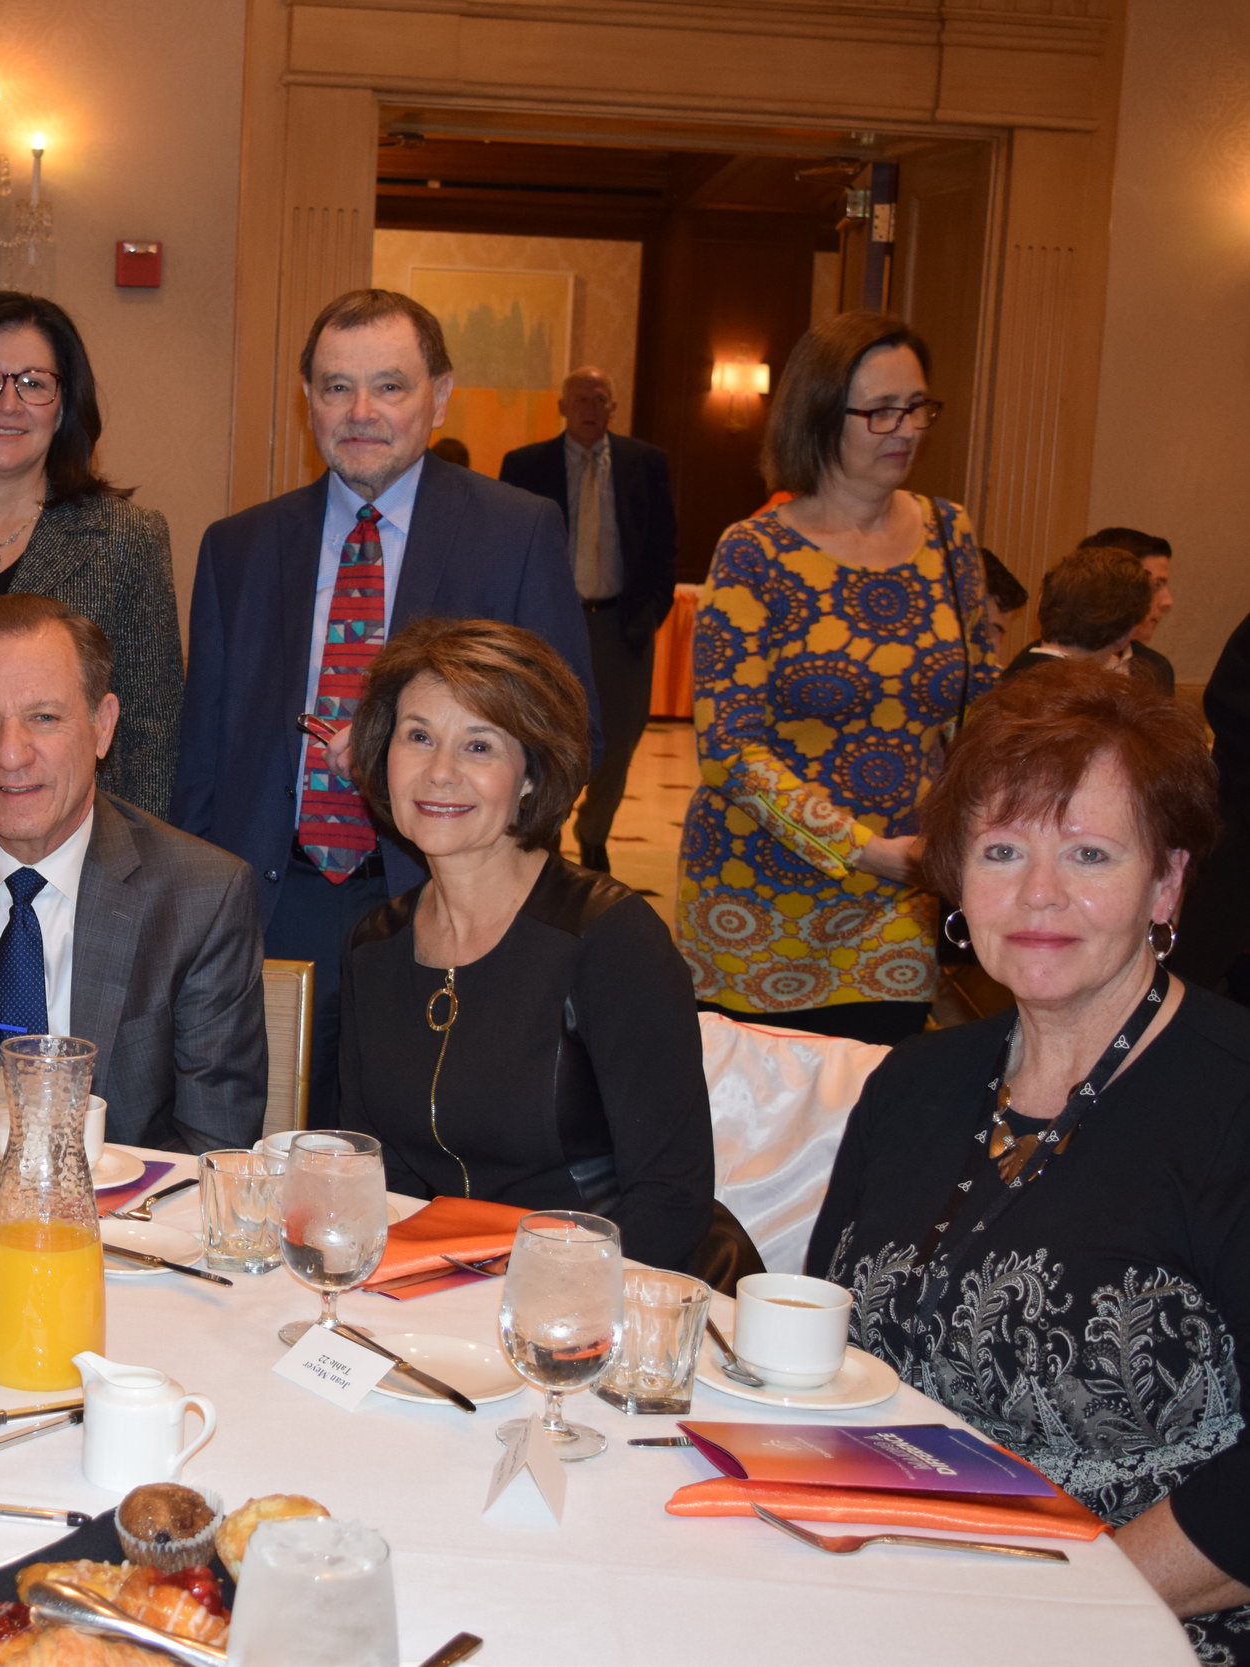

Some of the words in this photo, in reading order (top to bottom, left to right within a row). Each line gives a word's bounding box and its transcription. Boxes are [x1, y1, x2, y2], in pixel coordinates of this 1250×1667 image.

[318, 1354, 330, 1364] 22
[302, 1361, 329, 1379] Meyer
[329, 1360, 352, 1375] Table
[329, 1374, 351, 1389] Jean
[876, 1432, 958, 1476] DIFFERENCE
